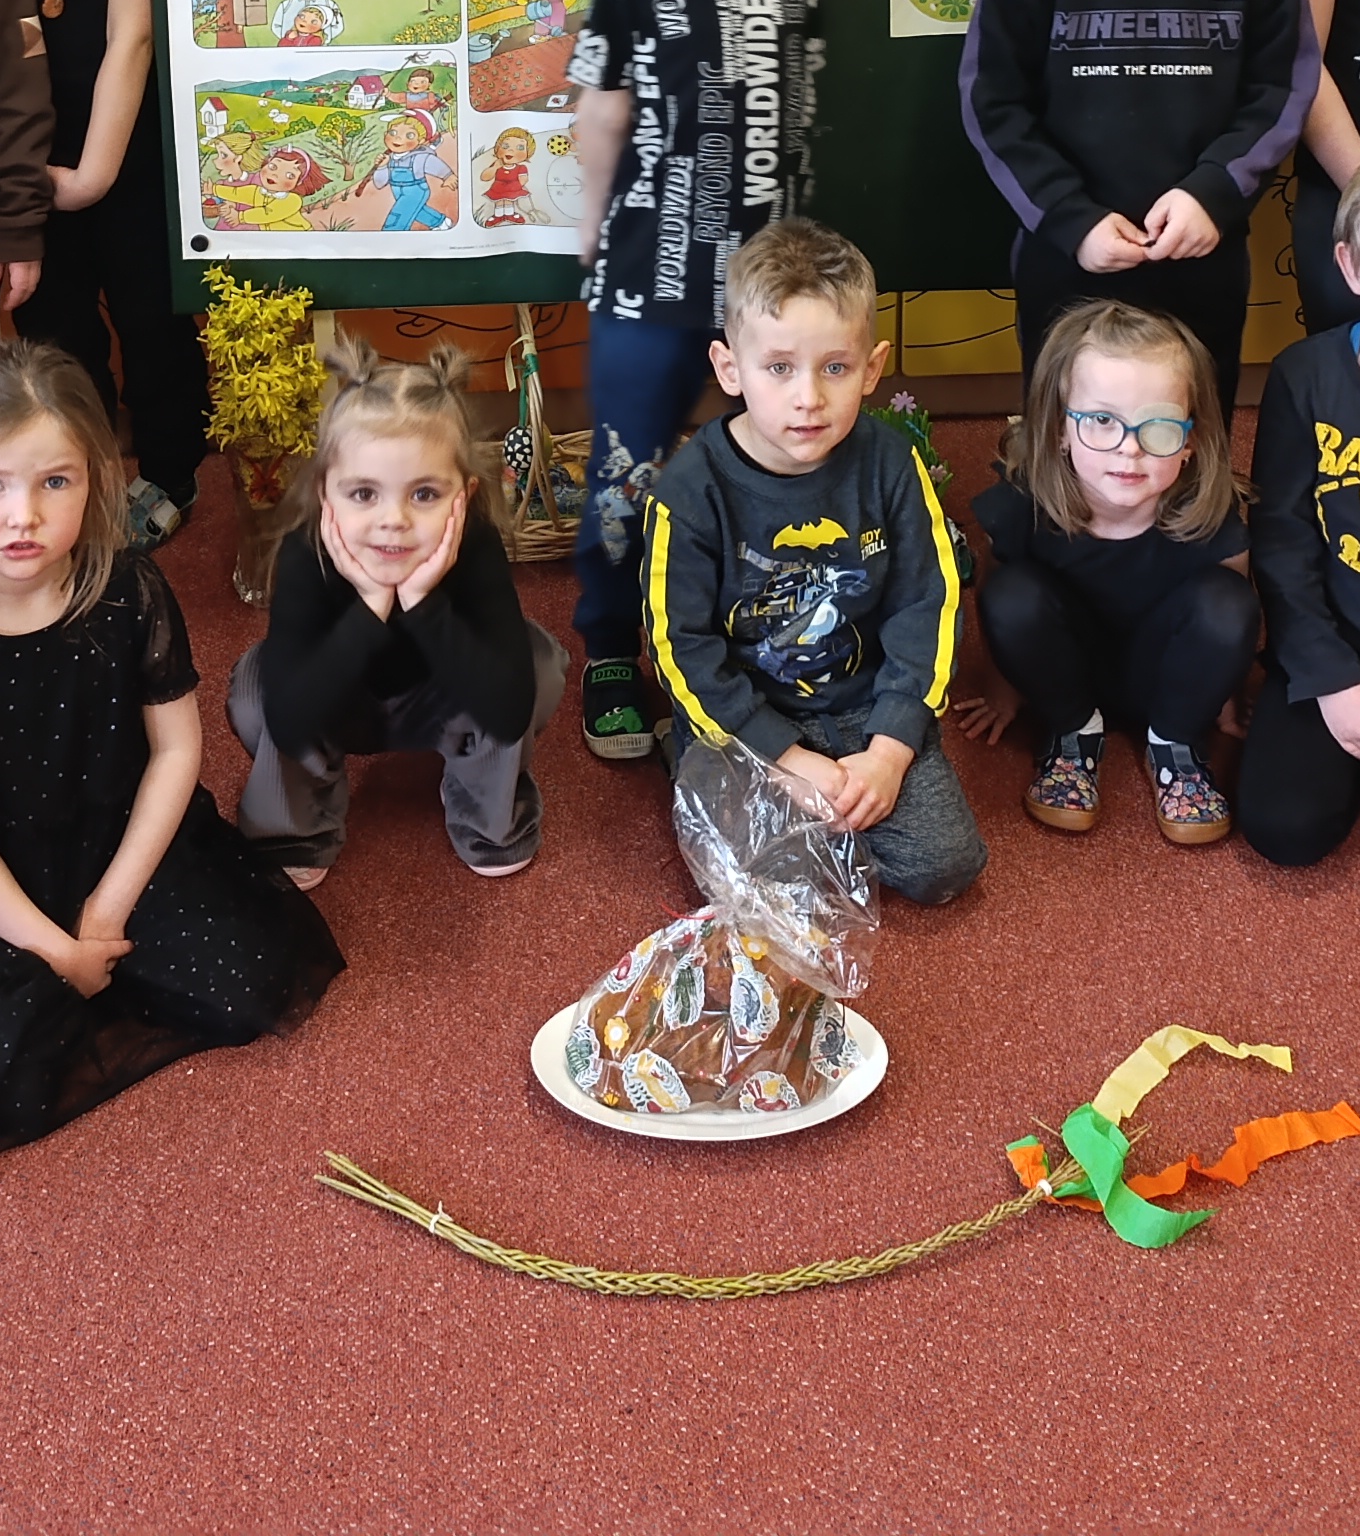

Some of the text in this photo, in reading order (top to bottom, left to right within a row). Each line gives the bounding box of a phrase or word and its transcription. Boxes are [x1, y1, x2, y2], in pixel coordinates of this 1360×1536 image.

[1051, 10, 1243, 51] MINECRAFT
[631, 37, 661, 99] EPIC
[1072, 64, 1213, 77] BEWARE THE ENDERMAN
[692, 60, 735, 243] BEYOND EPIC
[653, 154, 695, 302] WORLDWIDE
[594, 667, 630, 680] DINO
